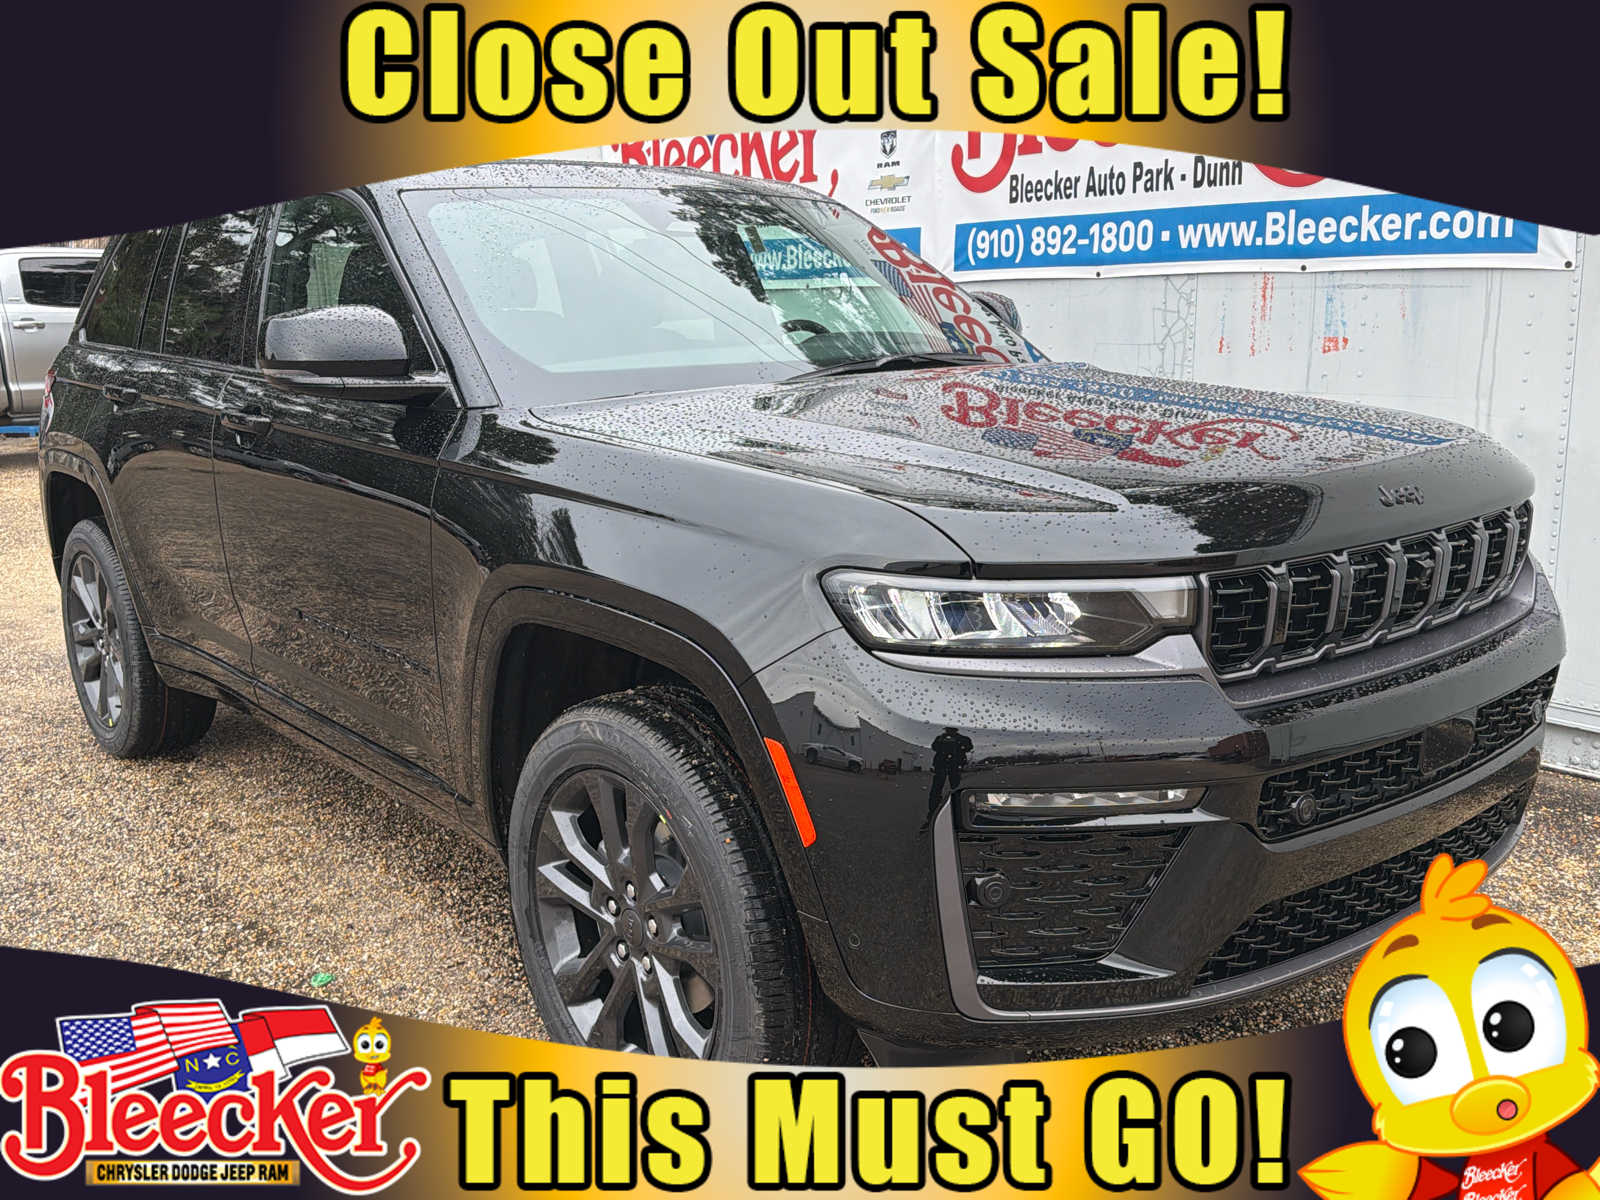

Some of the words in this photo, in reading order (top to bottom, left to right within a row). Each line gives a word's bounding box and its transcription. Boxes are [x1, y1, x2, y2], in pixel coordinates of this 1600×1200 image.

[876, 160, 901, 169] RAM
[1008, 168, 1081, 204] Bleecker
[1085, 166, 1126, 199] Auto
[1132, 158, 1175, 194] Park
[1193, 155, 1243, 189] Dunn
[865, 195, 912, 207] CHEVROLET
[967, 224, 1024, 266] (910)
[1030, 219, 1154, 256] 892-1800
[1177, 205, 1514, 249] www.Bleecker.com
[1377, 484, 1424, 507] Jeep
